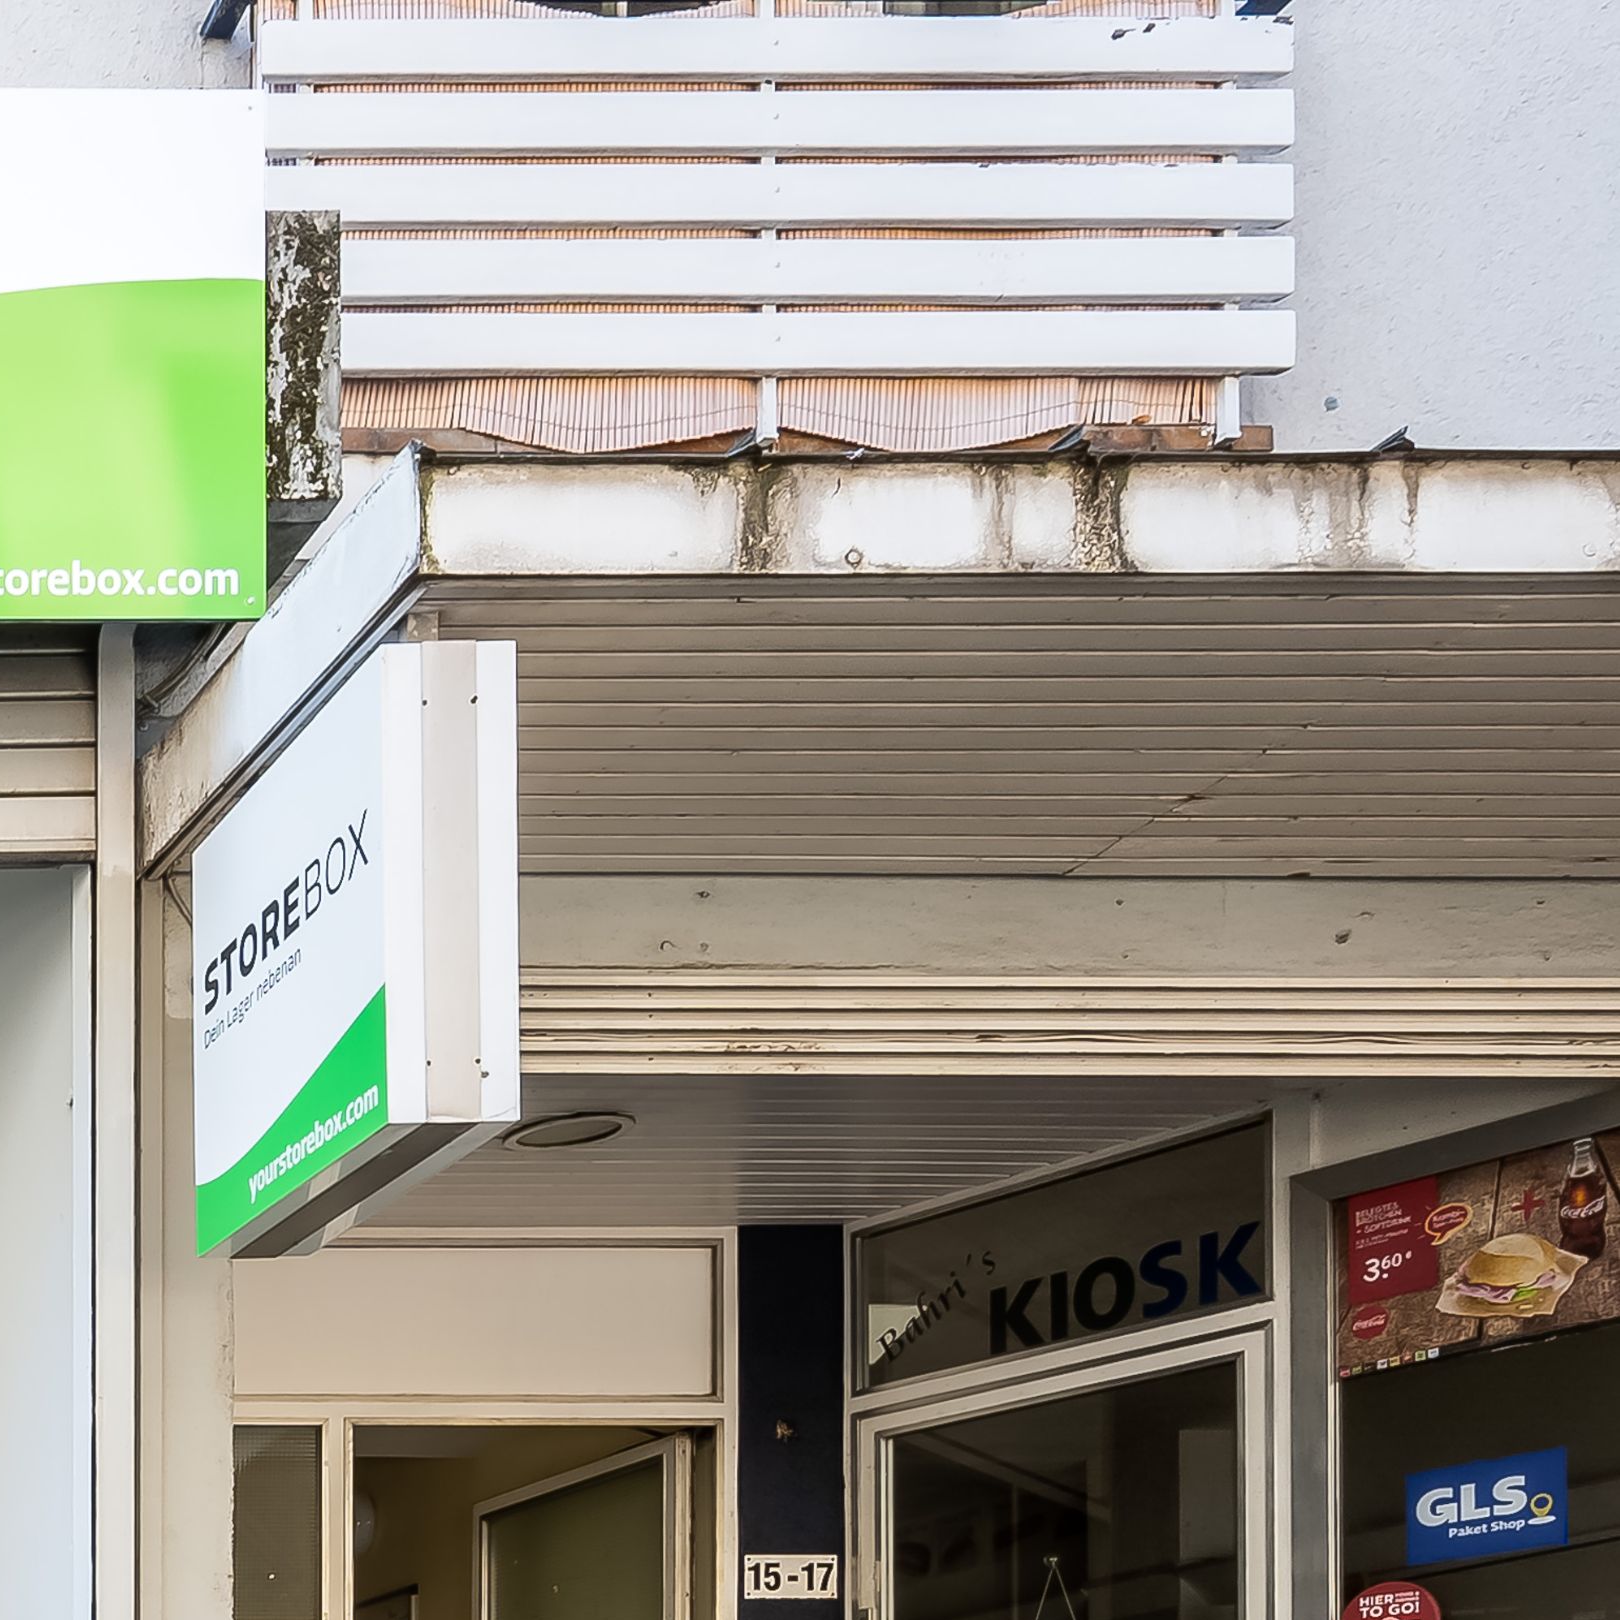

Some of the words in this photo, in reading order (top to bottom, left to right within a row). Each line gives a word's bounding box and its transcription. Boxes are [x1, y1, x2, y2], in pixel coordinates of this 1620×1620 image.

[204, 808, 369, 1016] STOREBOX
[204, 1016, 225, 1049] Dein
[226, 991, 254, 1028] Lager
[256, 948, 302, 1002] nebenan
[248, 1085, 379, 1204] yourstorebox.com
[989, 1220, 1262, 1355] KIOSK
[1416, 1475, 1528, 1527] GLS
[1448, 1522, 1488, 1538] Paket
[1491, 1519, 1525, 1532] Shop
[1359, 1594, 1394, 1607] HIER
[1359, 1606, 1383, 1618] TO
[1388, 1601, 1420, 1615] GO!
